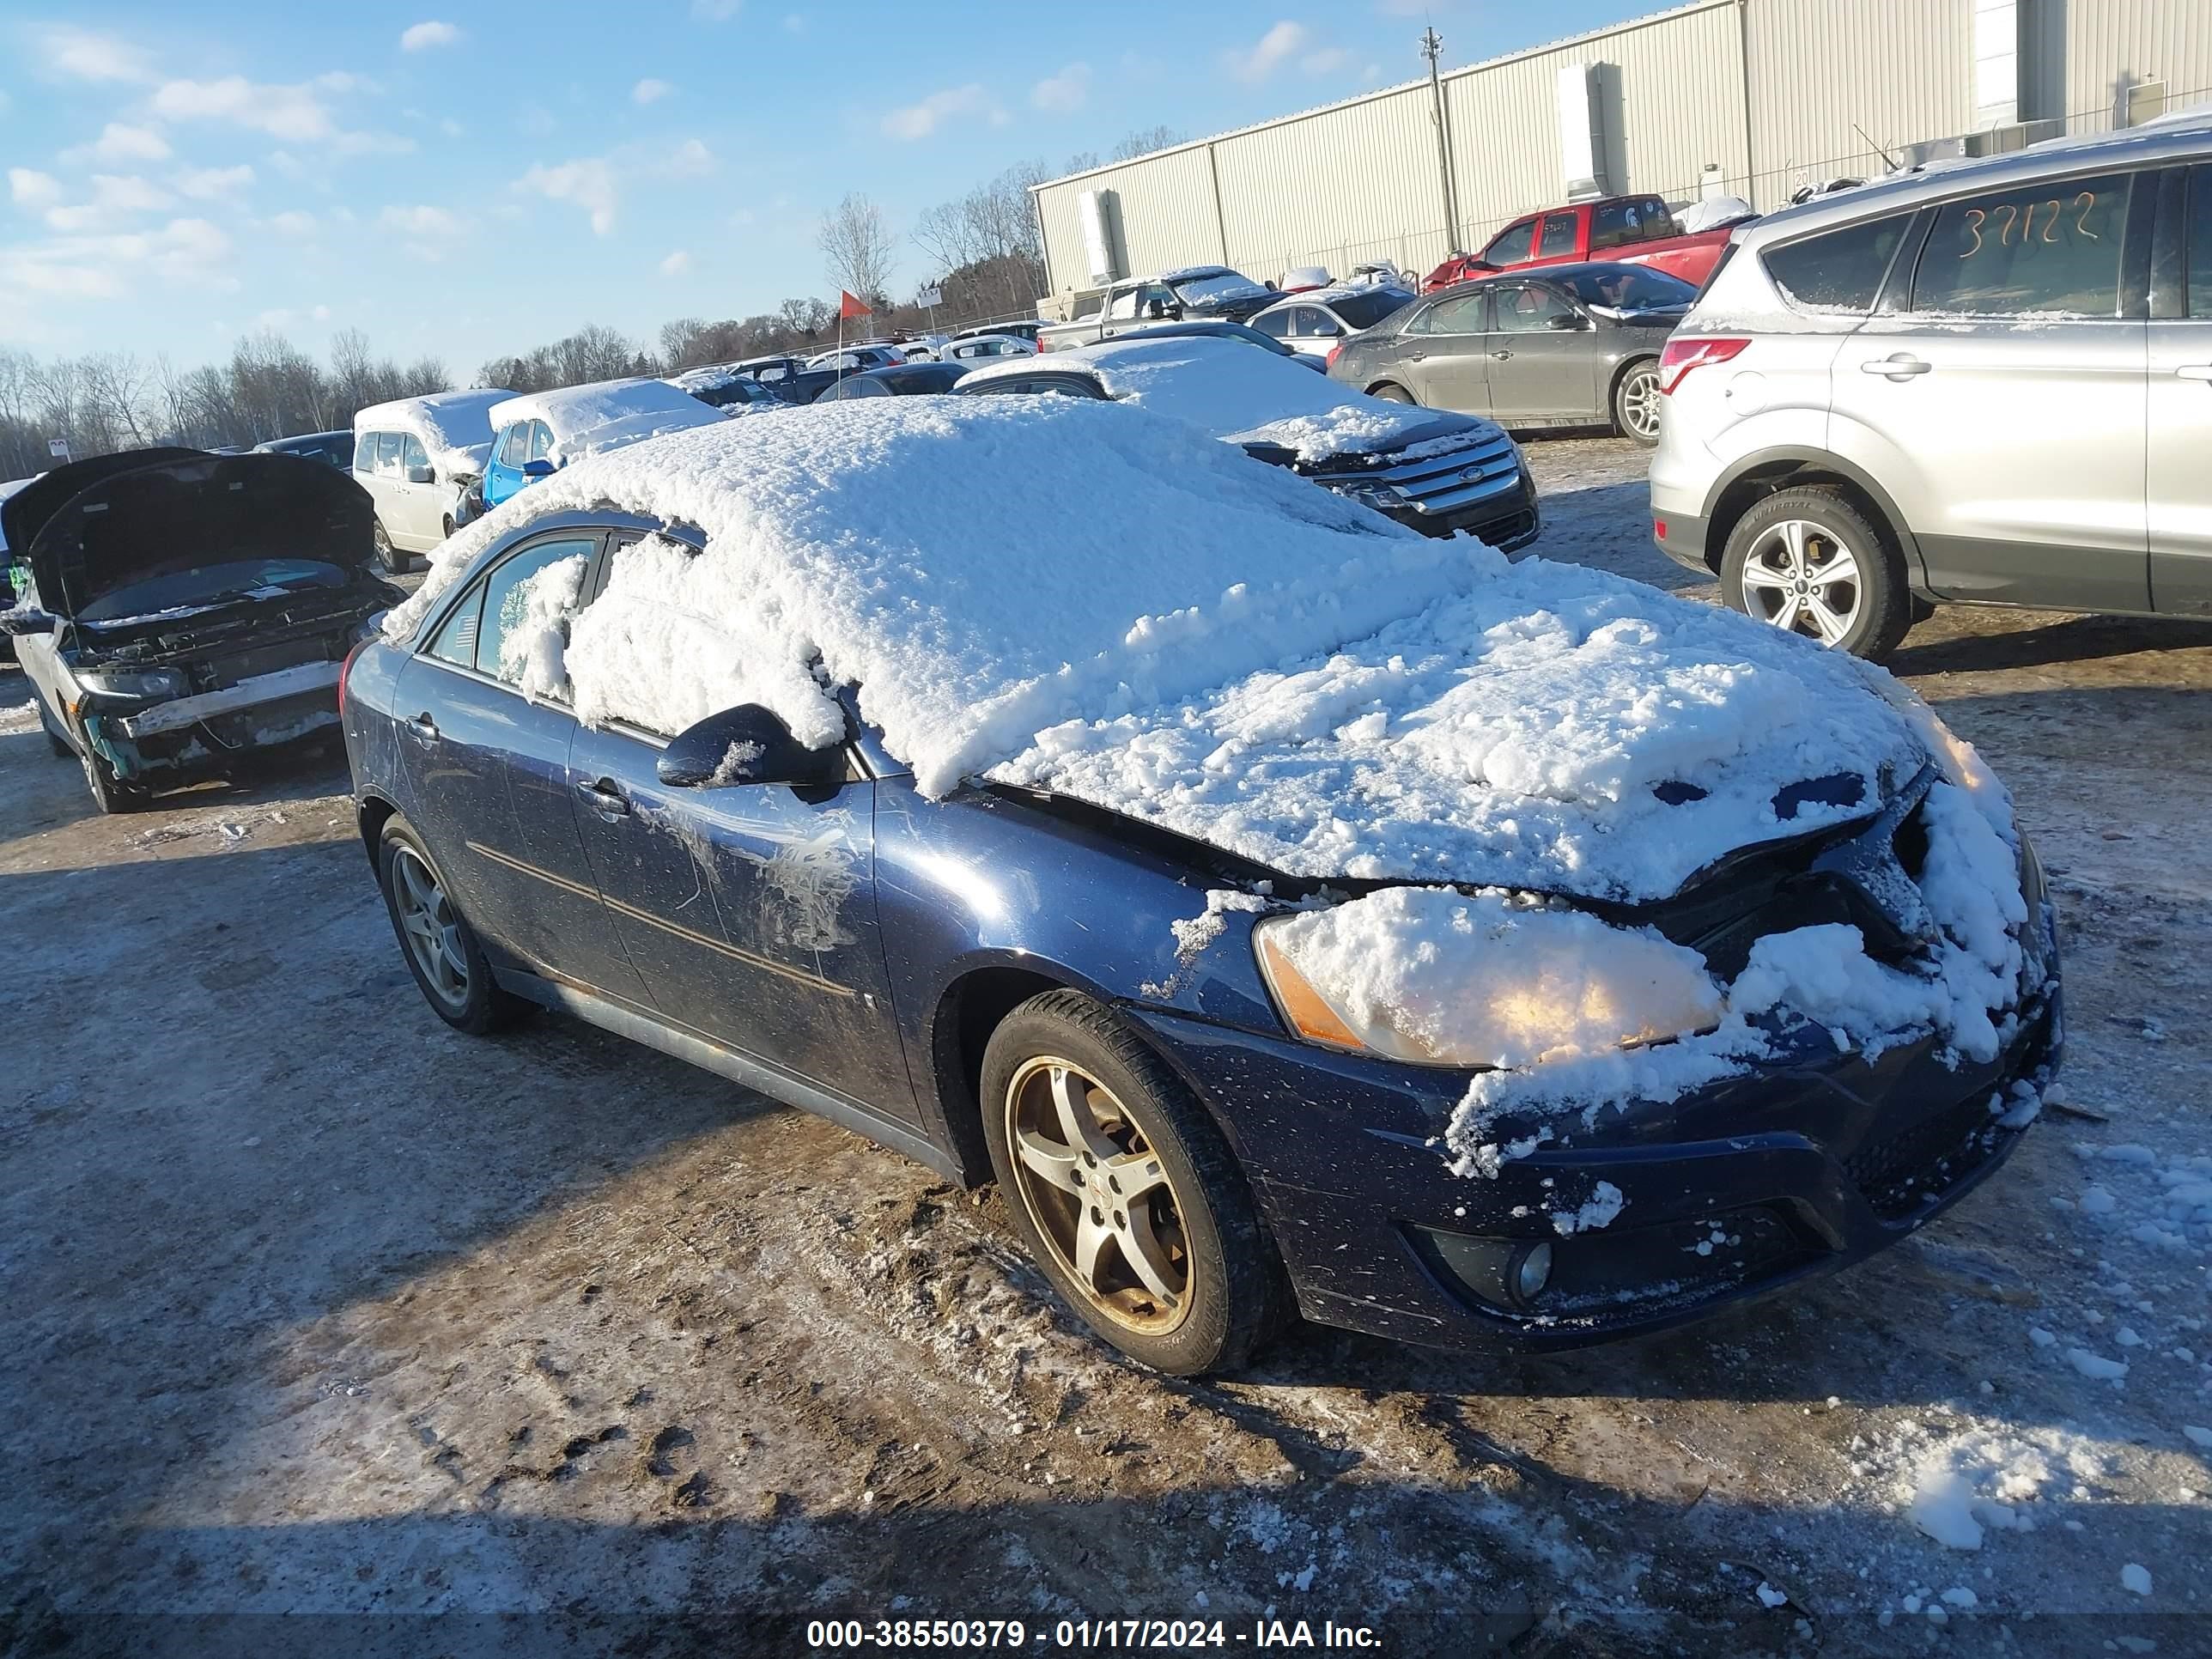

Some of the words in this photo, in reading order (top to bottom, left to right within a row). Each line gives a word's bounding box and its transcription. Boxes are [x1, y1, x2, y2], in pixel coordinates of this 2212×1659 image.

[1795, 172, 1808, 187] 20
[1958, 191, 2098, 258] 37122
[1753, 500, 1812, 522] UNIROYAL
